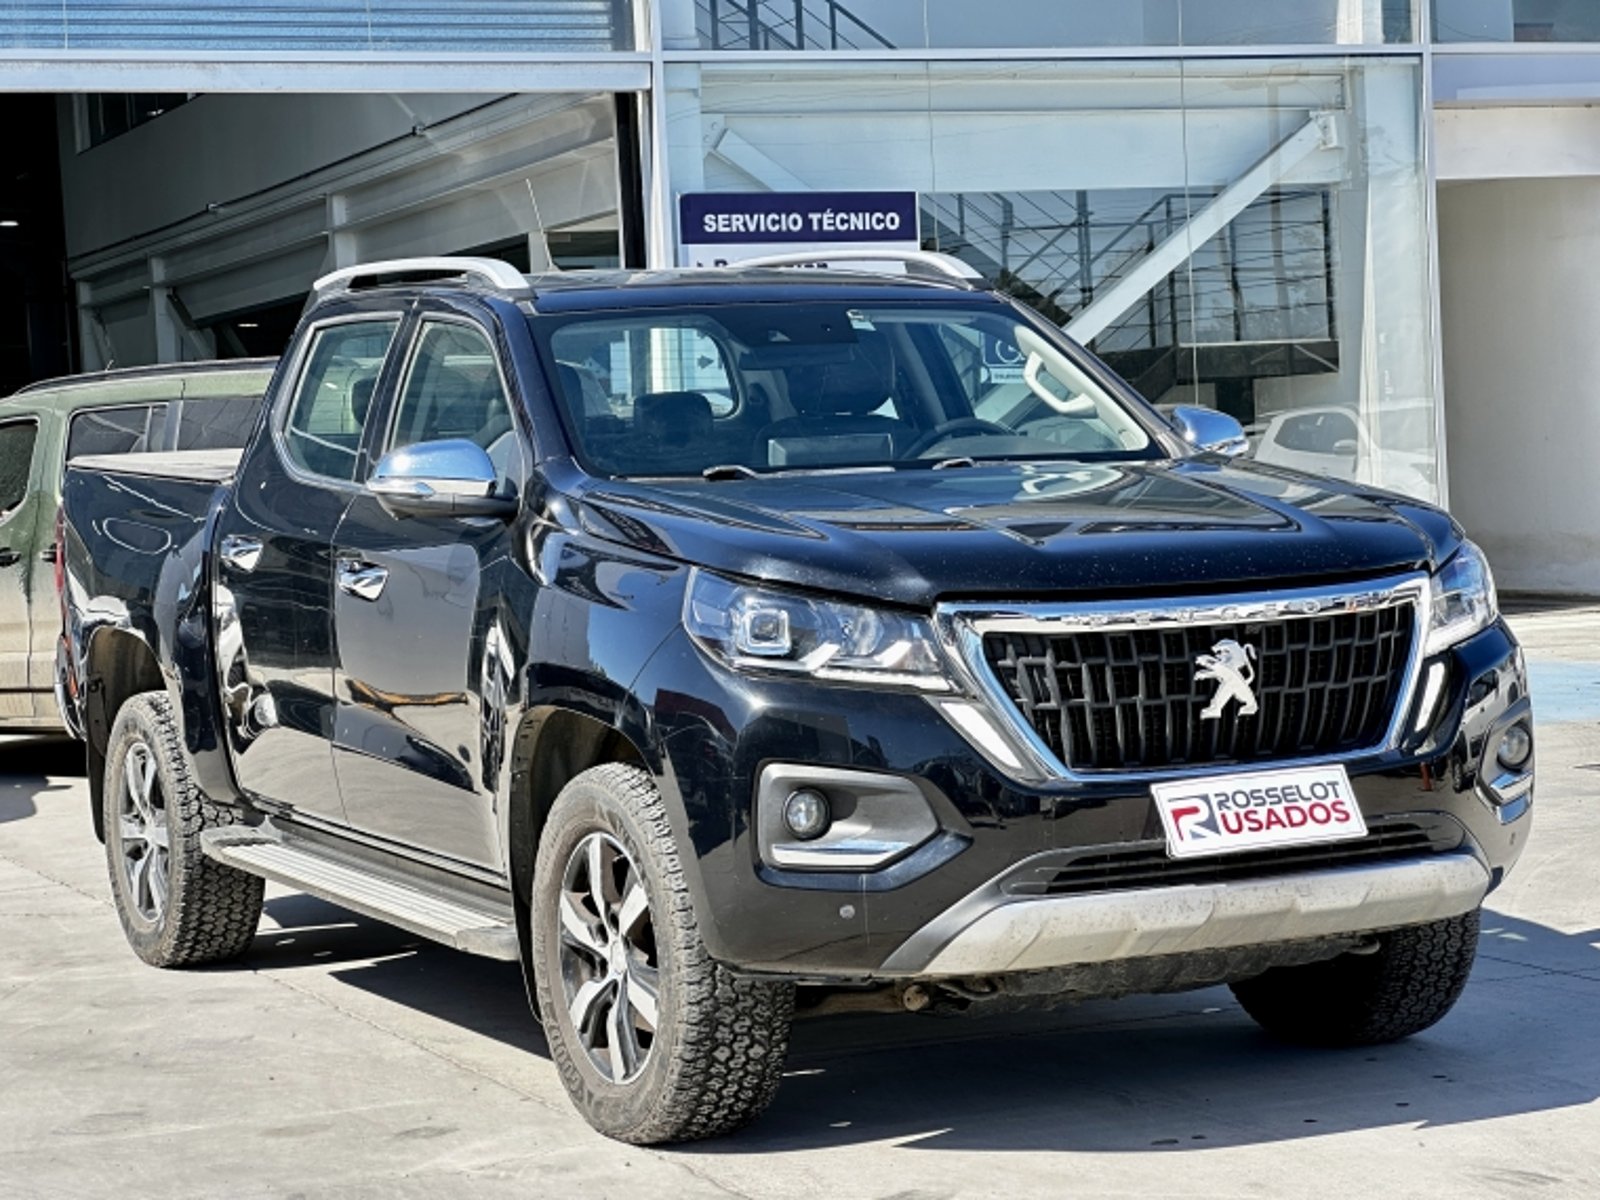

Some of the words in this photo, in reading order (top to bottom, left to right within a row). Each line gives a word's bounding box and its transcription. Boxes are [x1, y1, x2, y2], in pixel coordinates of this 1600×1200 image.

[703, 213, 803, 233] SERVICIO
[808, 208, 900, 231] TÉCNICO
[1214, 781, 1340, 811] ROSSELOT
[1220, 800, 1350, 834] USADOS
